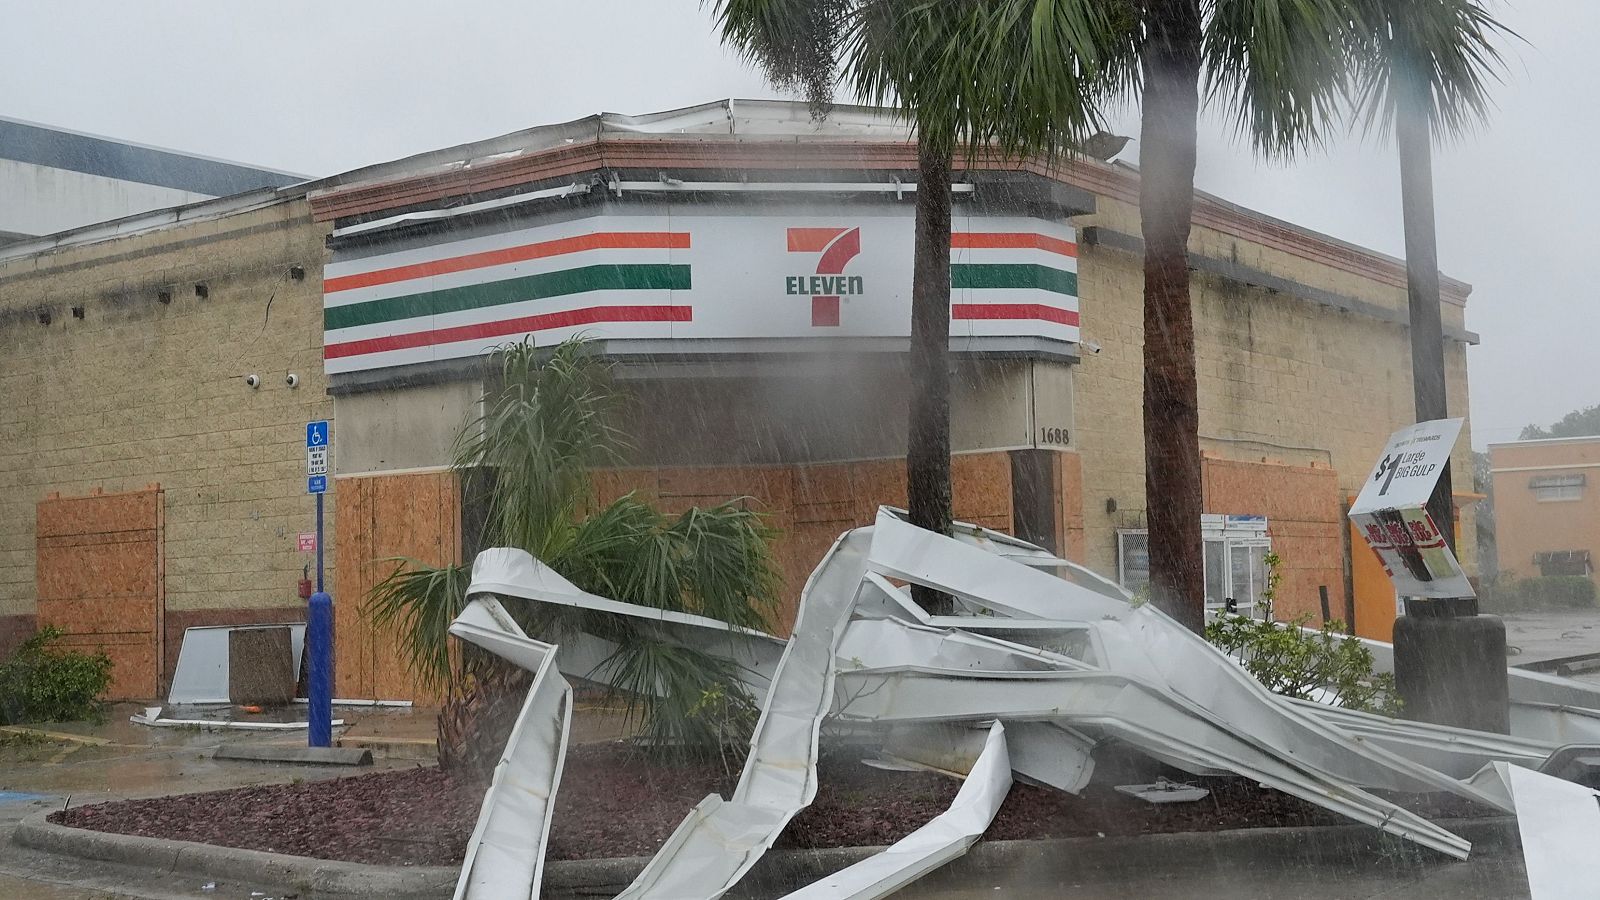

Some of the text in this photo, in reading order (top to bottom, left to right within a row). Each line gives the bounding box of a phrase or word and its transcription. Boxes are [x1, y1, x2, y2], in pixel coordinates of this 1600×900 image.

[787, 227, 860, 326] 7
[1041, 427, 1069, 445] 1688
[1402, 450, 1426, 464] Large
[1394, 463, 1435, 479] BIG GULP
